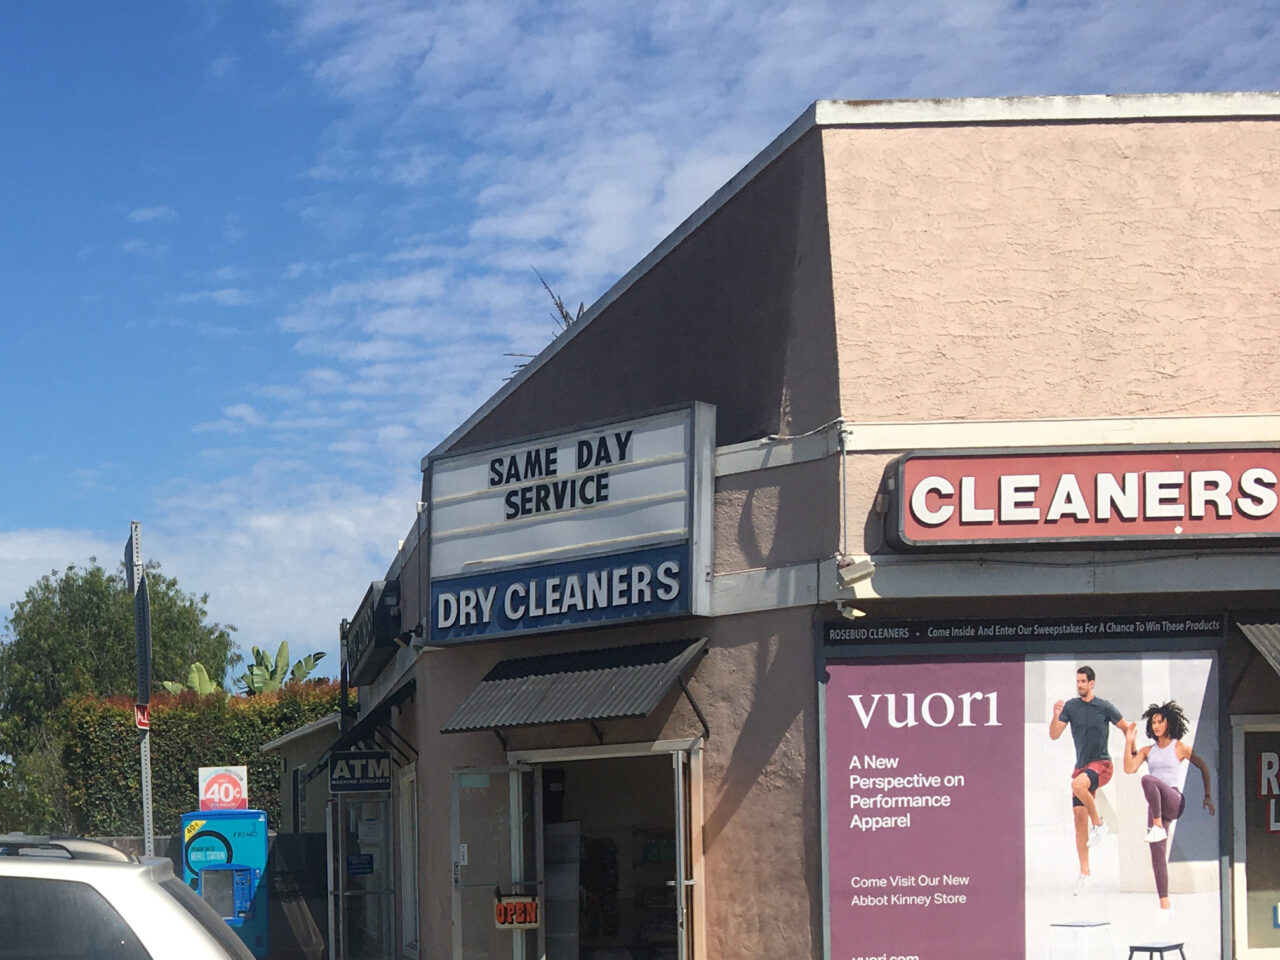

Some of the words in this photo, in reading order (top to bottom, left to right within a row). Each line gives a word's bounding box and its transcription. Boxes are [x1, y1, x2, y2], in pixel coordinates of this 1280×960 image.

[489, 446, 558, 487] SAME
[577, 430, 633, 470] DAY
[505, 472, 609, 520] SERVICE
[911, 468, 1278, 526] CLEANERS
[437, 585, 497, 630] DRY
[504, 560, 681, 619] CLEANERS
[829, 629, 867, 640] ROSEBUD
[869, 628, 909, 638] CLEANERS
[927, 627, 950, 637] Come
[951, 626, 975, 636] Inside
[977, 625, 994, 635] And
[995, 625, 1016, 635] Enter
[1017, 625, 1032, 634] Our
[1033, 623, 1084, 636] Sweepstakes
[1085, 623, 1098, 632] For
[1099, 623, 1105, 632] A
[1106, 622, 1134, 632] Chance
[1135, 622, 1144, 631] To
[1145, 622, 1161, 631] Win
[1162, 621, 1184, 630] These
[1185, 620, 1220, 630] Products
[848, 690, 1003, 728] vuori
[332, 758, 390, 779] ATM
[849, 755, 861, 769] A
[864, 755, 899, 769] New
[850, 773, 941, 791] Perspective
[944, 776, 964, 787] on
[850, 794, 951, 809] Performance
[850, 813, 911, 831] Apparel
[851, 876, 887, 888] Come
[889, 875, 915, 887] Visit
[918, 875, 940, 887] Our
[943, 874, 970, 886] New
[851, 894, 888, 906] Abbot
[891, 893, 932, 909] Kinney
[934, 892, 967, 905] Store
[496, 902, 538, 924] OPEN
